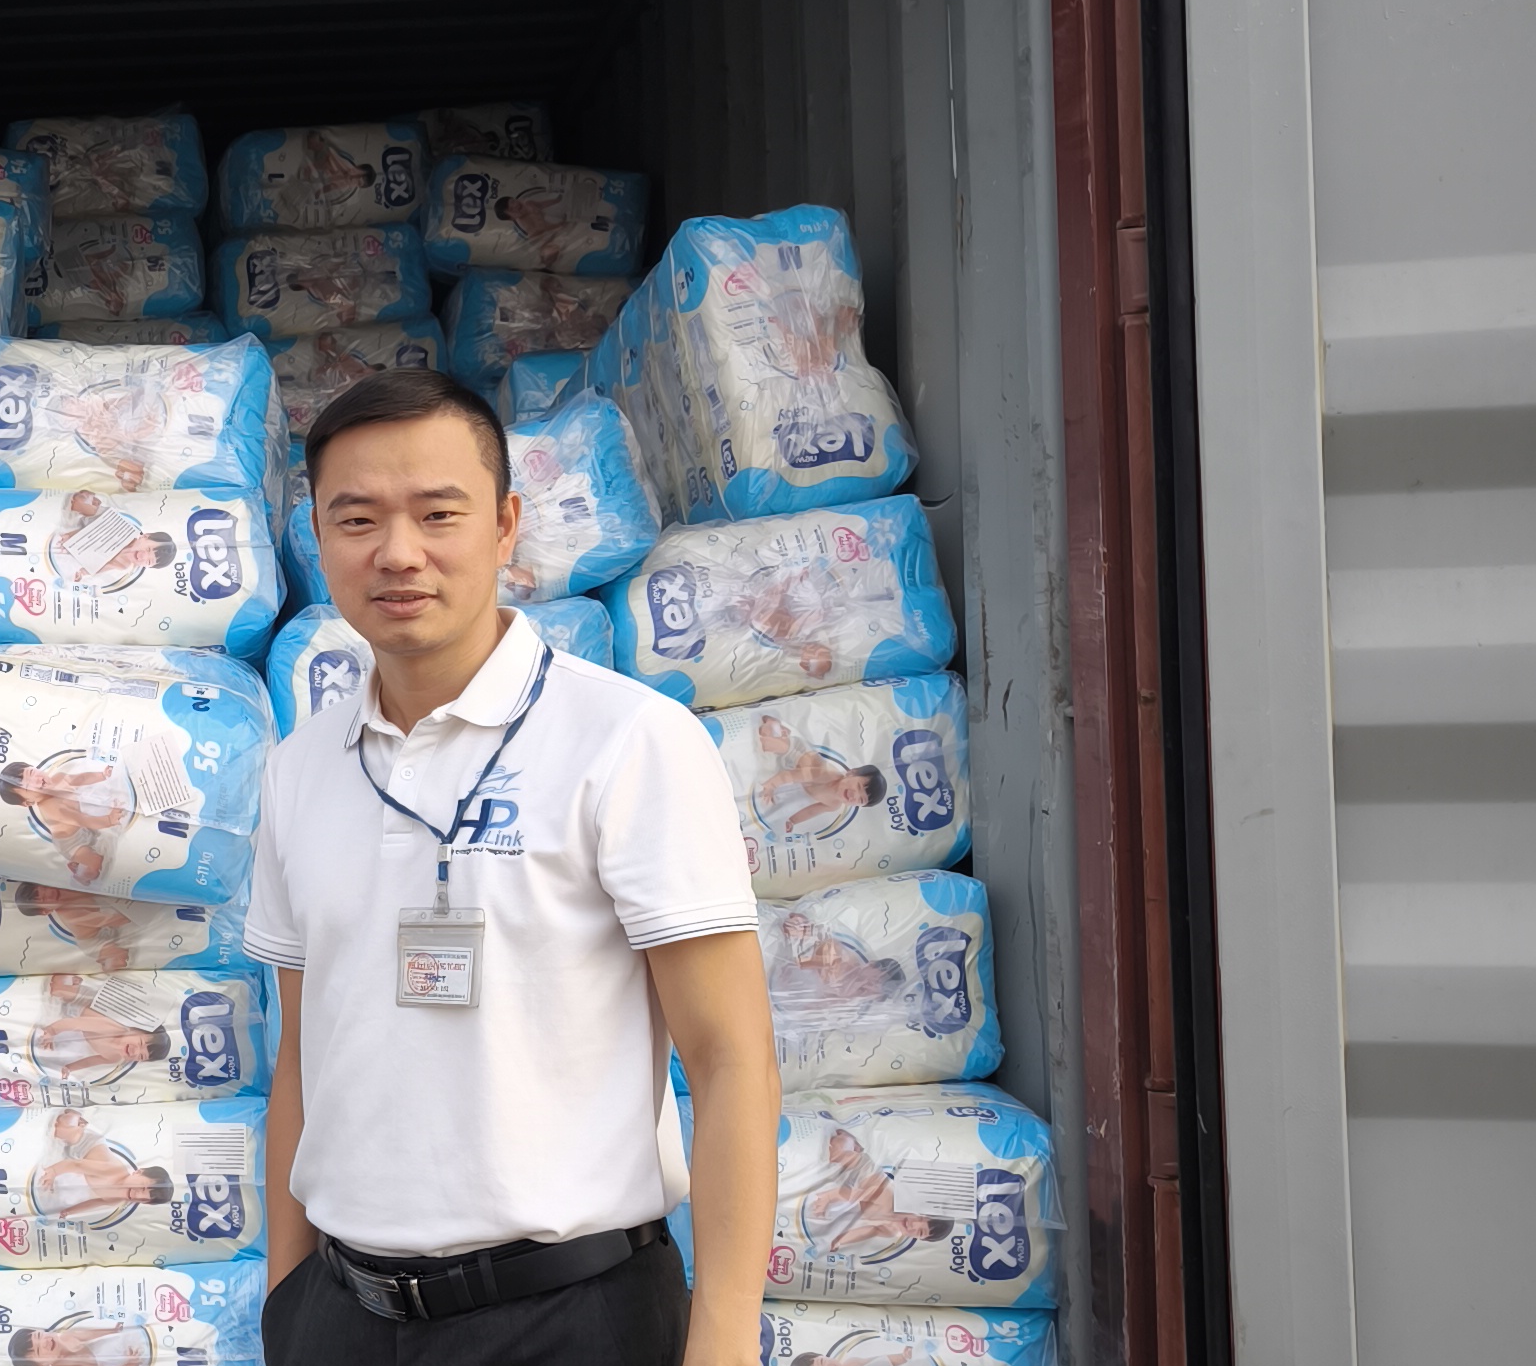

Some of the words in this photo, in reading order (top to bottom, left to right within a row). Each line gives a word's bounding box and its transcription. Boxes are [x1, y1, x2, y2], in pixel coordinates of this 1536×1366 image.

[174, 562, 187, 596] baby
[651, 583, 661, 604] new
[193, 741, 221, 775] 56
[886, 796, 904, 833] baby
[484, 830, 525, 846] Link
[227, 1055, 236, 1078] new
[170, 1201, 186, 1235] baby
[198, 1173, 232, 1232] ex
[950, 1236, 965, 1275] baby
[1016, 1237, 1025, 1263] new
[200, 1278, 226, 1308] 56
[776, 1316, 793, 1358] baby
